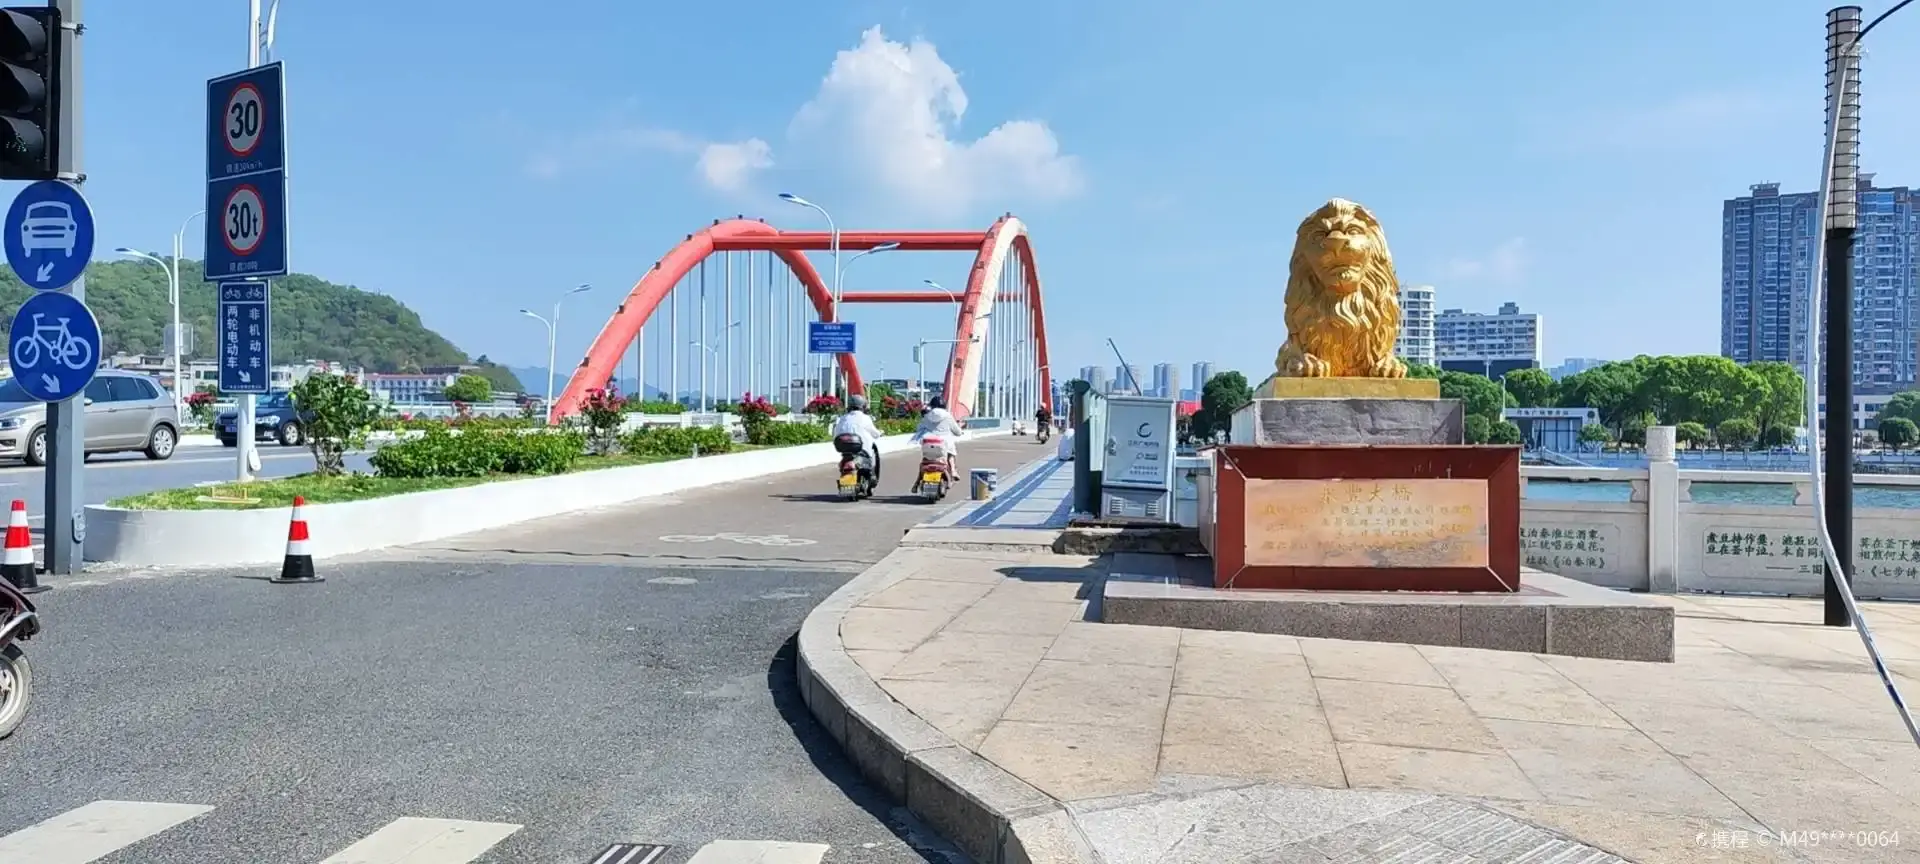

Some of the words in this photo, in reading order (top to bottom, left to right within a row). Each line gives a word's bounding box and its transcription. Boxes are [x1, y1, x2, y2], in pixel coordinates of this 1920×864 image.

[230, 100, 259, 139] 30
[228, 202, 258, 239] 30t
[226, 305, 239, 368] 两轮电动车
[249, 307, 261, 368] 非机动车
